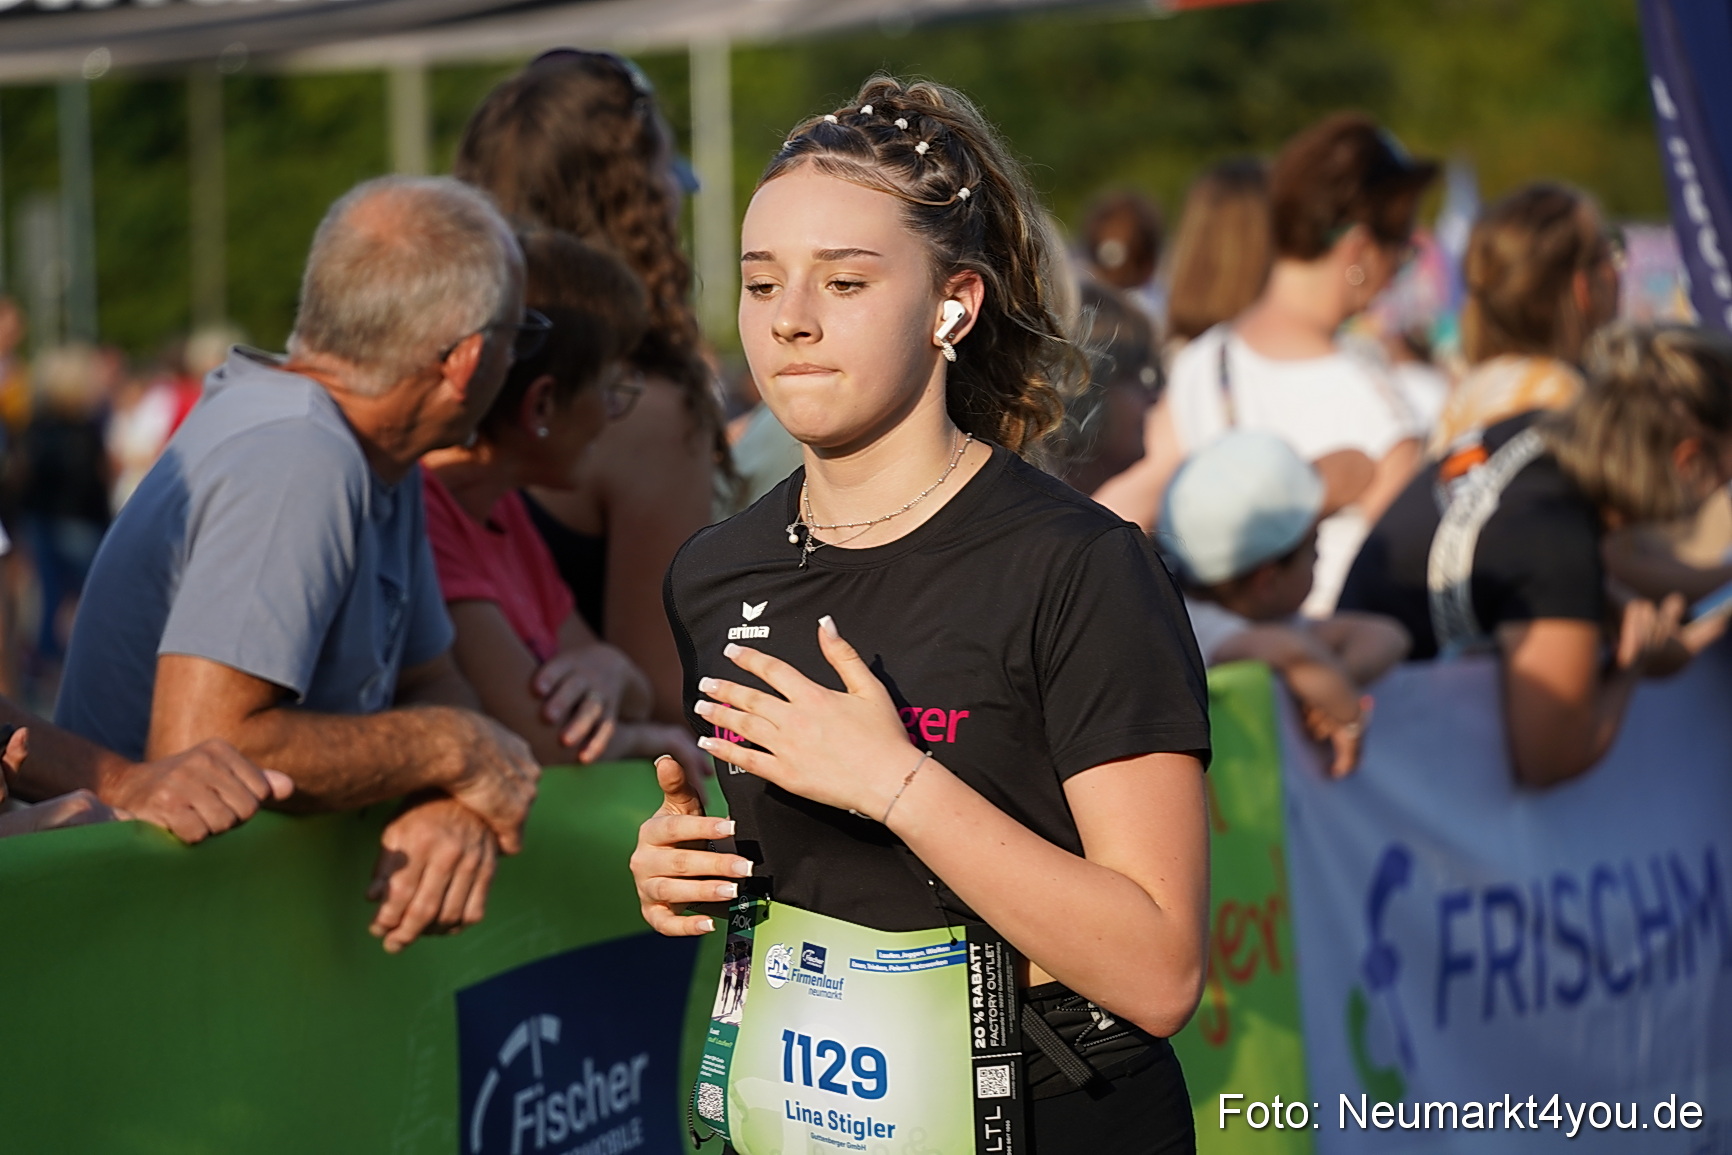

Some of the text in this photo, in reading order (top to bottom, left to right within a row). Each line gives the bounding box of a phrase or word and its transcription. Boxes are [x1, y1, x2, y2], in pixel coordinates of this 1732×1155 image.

[728, 623, 770, 640] erima
[731, 914, 752, 930] AOK
[791, 968, 844, 991] Firmenlauf
[808, 987, 843, 1000] neumarkt
[985, 943, 1000, 1047] FACTORY OUTLET
[969, 943, 986, 1049] 20 % RABATT
[781, 1028, 888, 1100] 1129
[510, 1051, 650, 1155] Fischer
[785, 1099, 896, 1141] Lina Stigler
[846, 1141, 867, 1151] GmbH
